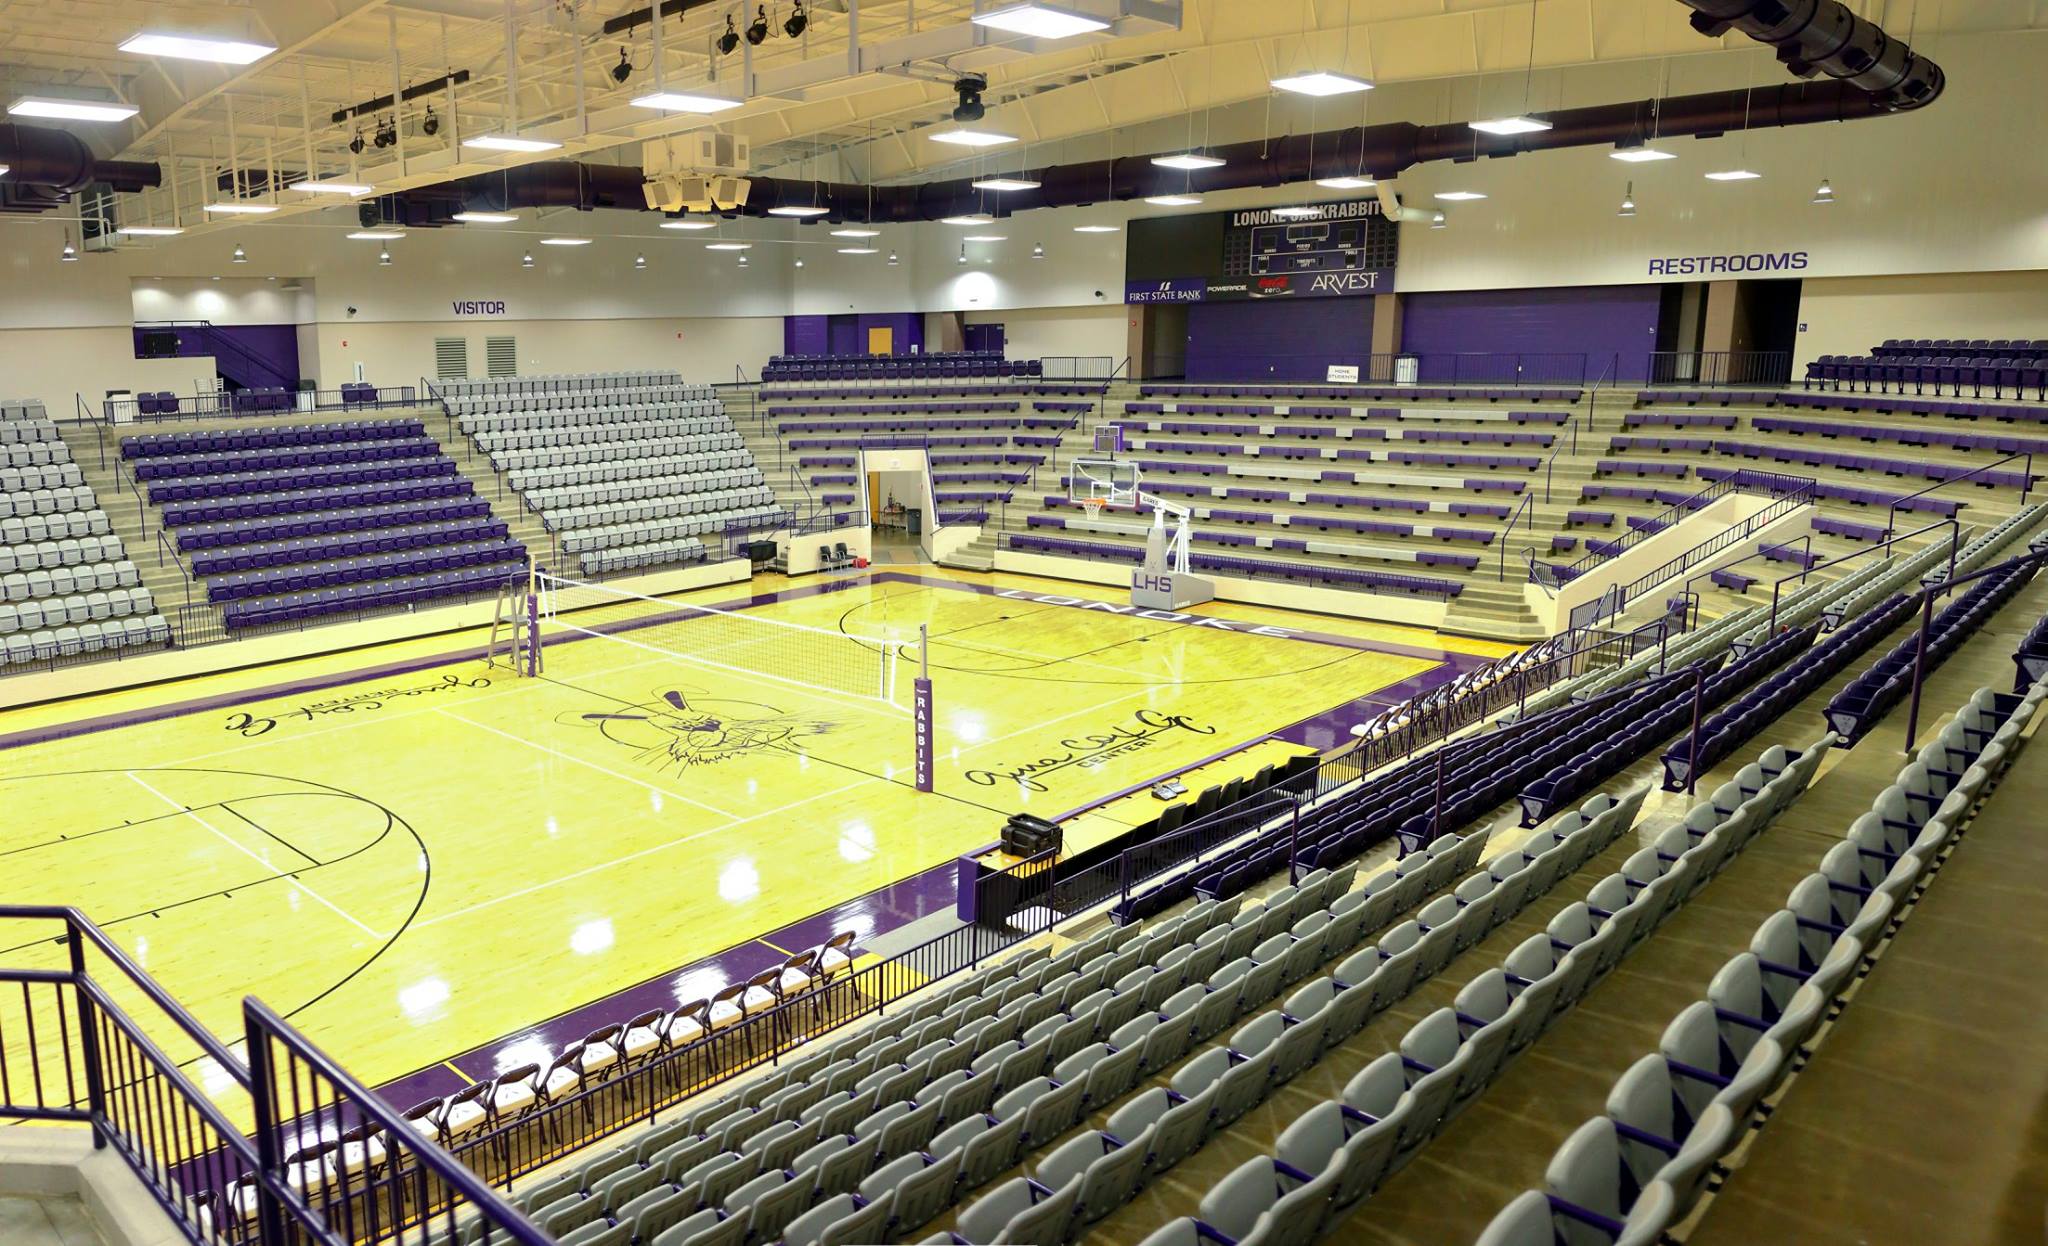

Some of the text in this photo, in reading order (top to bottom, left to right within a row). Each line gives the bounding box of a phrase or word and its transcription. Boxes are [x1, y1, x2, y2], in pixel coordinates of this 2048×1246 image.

[1290, 200, 1385, 222] CKRABBIT
[1648, 251, 1809, 276] RESTROOMS
[1310, 272, 1378, 295] ARVEST
[1129, 289, 1201, 302] FIRST STATE BANK
[453, 301, 505, 314] VISITOR
[1133, 573, 1172, 593] LHS
[998, 590, 1305, 637] LONOKE
[917, 696, 925, 784] RABBITS
[1076, 739, 1149, 768] CENTER
